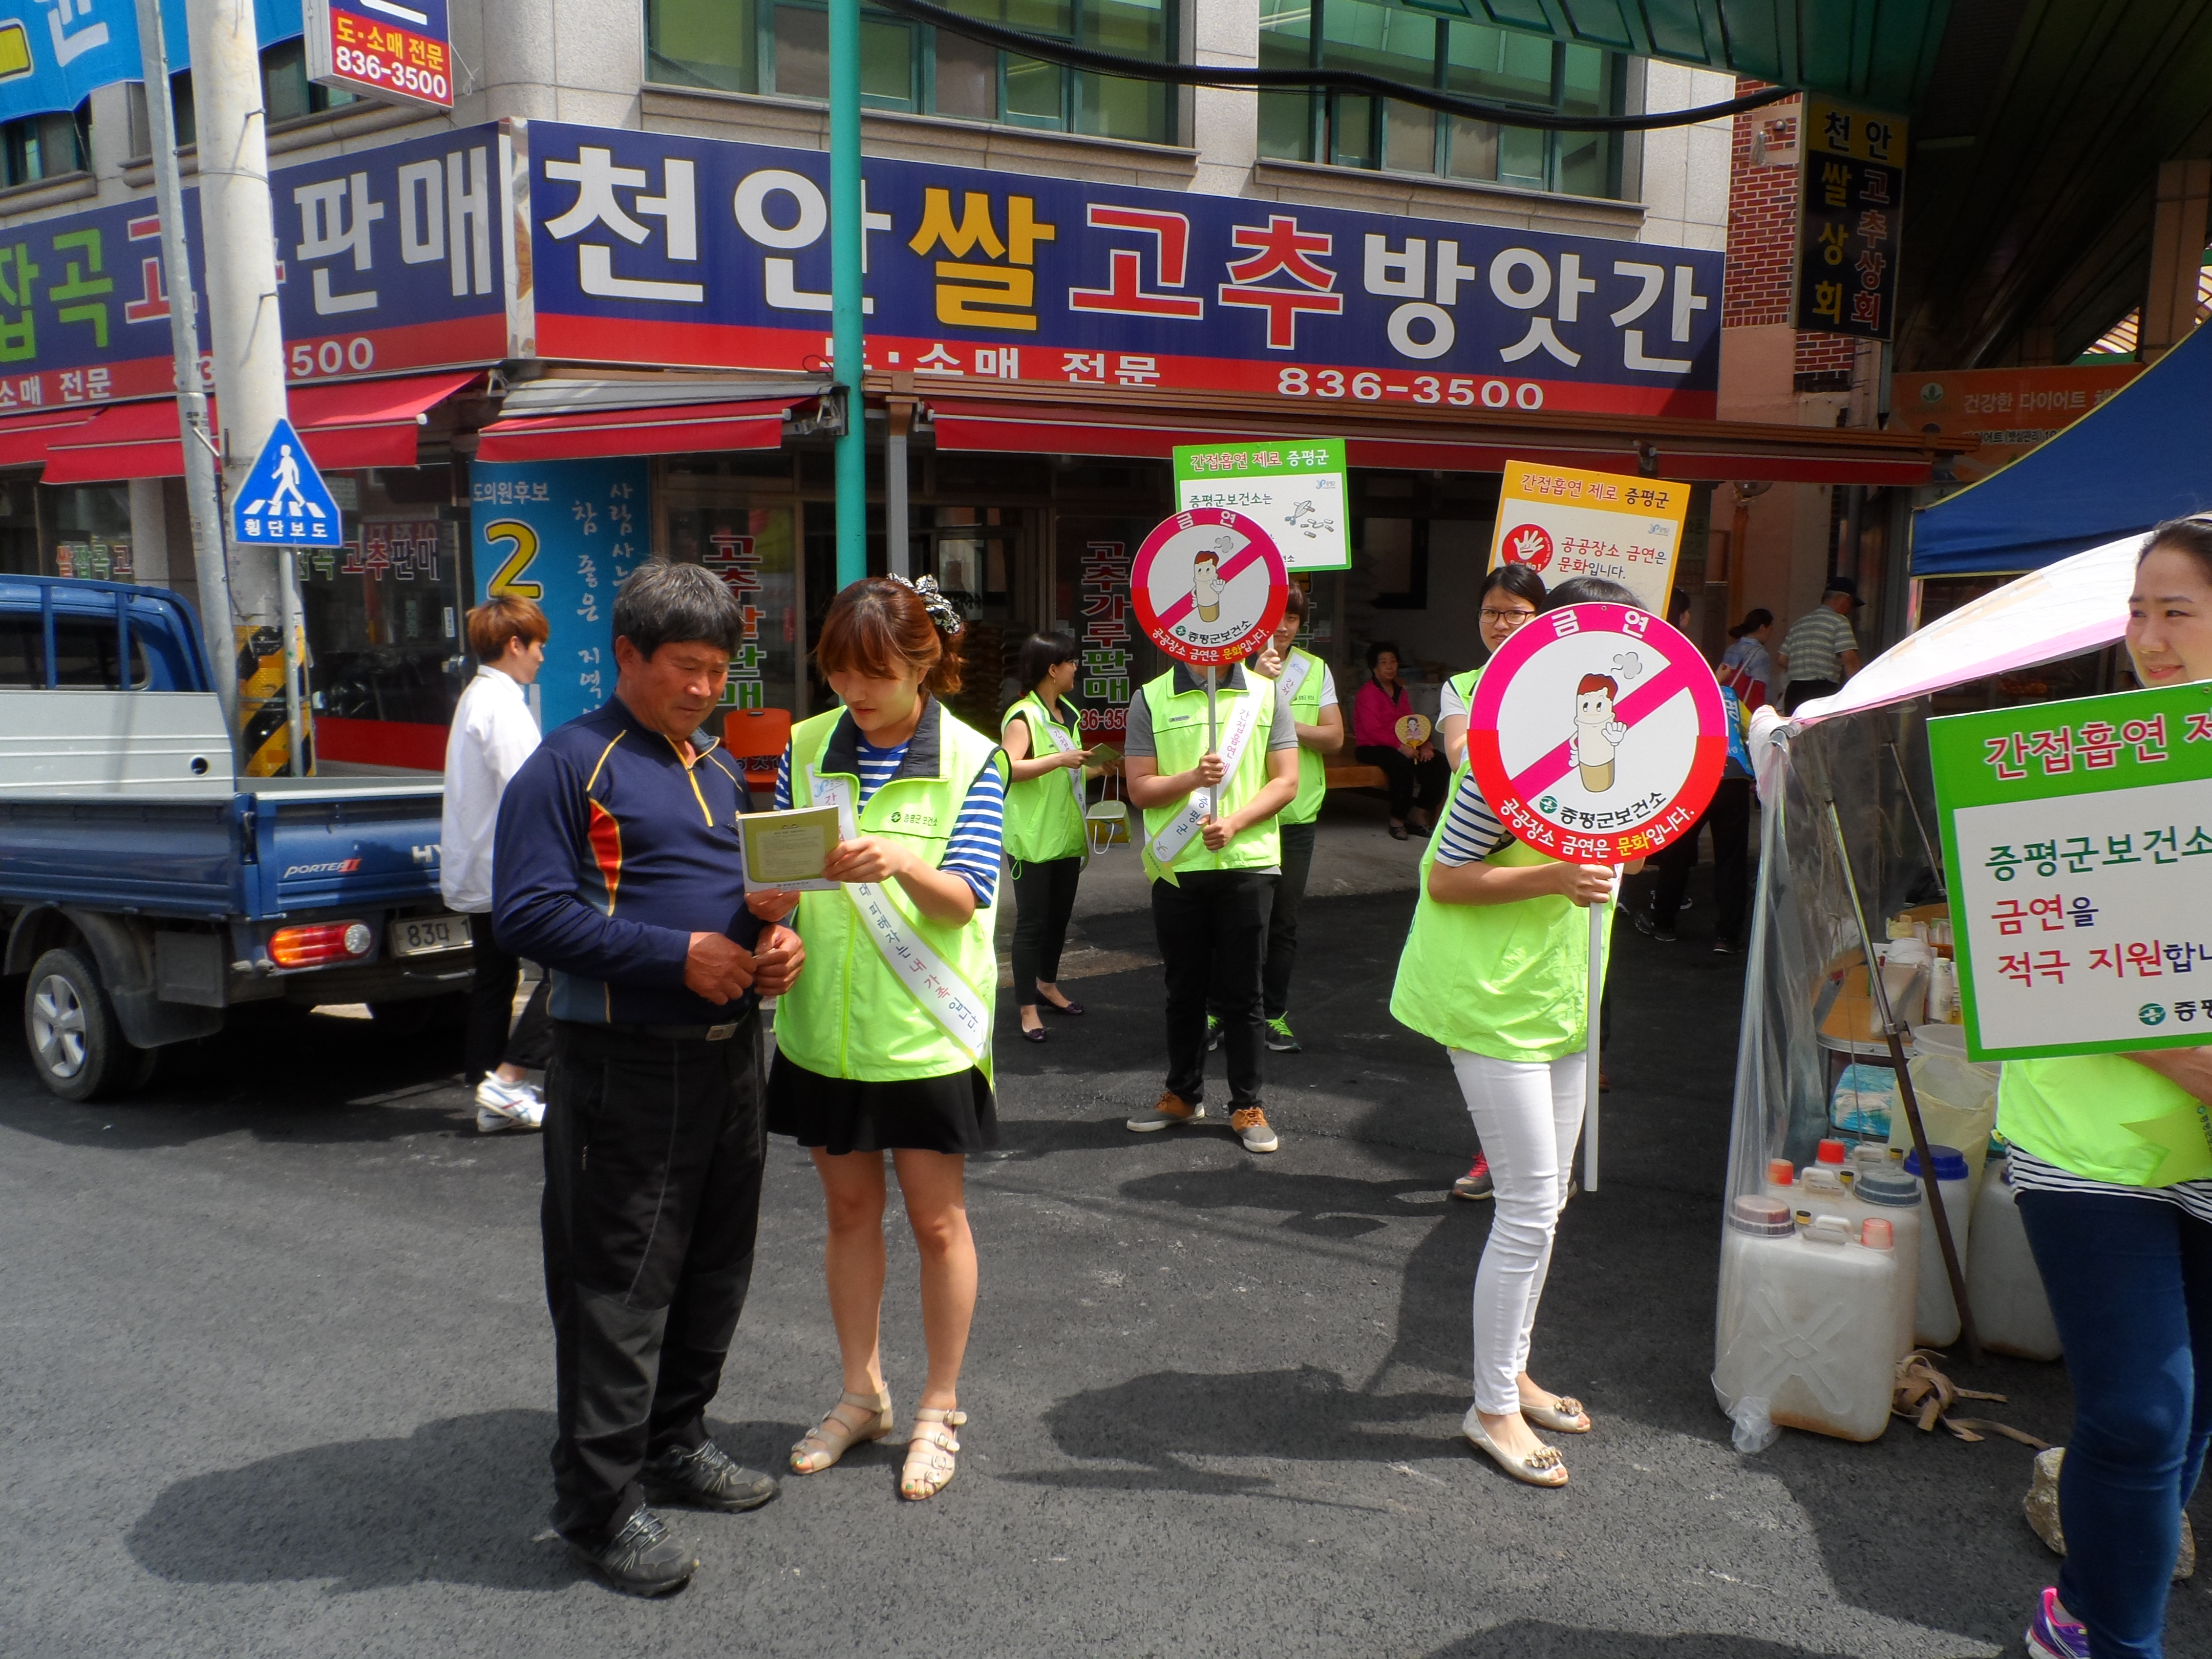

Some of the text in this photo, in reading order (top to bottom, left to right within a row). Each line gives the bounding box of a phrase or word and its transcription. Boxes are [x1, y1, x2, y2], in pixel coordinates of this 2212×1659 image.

[336, 17, 443, 71] 도·소매 전문
[336, 46, 447, 98] 836-3500
[59, 368, 111, 401] 전문
[1061, 352, 1160, 388] 전문
[1277, 367, 1544, 410] 836-3500
[1964, 392, 2012, 413] 건강한
[2019, 390, 2086, 411] 다이어트
[1190, 449, 1330, 472] 간접흡연 제로 증평군
[473, 481, 550, 505] 도의원후보
[1189, 493, 1273, 508] 증평군보건소는
[1520, 474, 1670, 509] 간접흡연 제로 증평군
[244, 518, 328, 538] 횡단보도
[484, 518, 544, 603] 2
[1557, 556, 1626, 579] 문화입니다.
[1561, 536, 1621, 558] 공공장소
[1626, 545, 1667, 565] 금연은
[1152, 627, 1270, 662] 공공장소 금연은 문화입니다.
[1188, 620, 1252, 645] 증평군보건소
[1227, 709, 1250, 759] 간접흡연
[1984, 712, 2169, 781] 간접흡연
[1500, 797, 1695, 859] 공공장소 금연은 문화입니다.
[1560, 791, 1667, 829] 증평군보건소
[1985, 825, 2212, 882] 증평군보건소
[1991, 894, 2099, 936] 금연을
[1998, 949, 2071, 988] 적극
